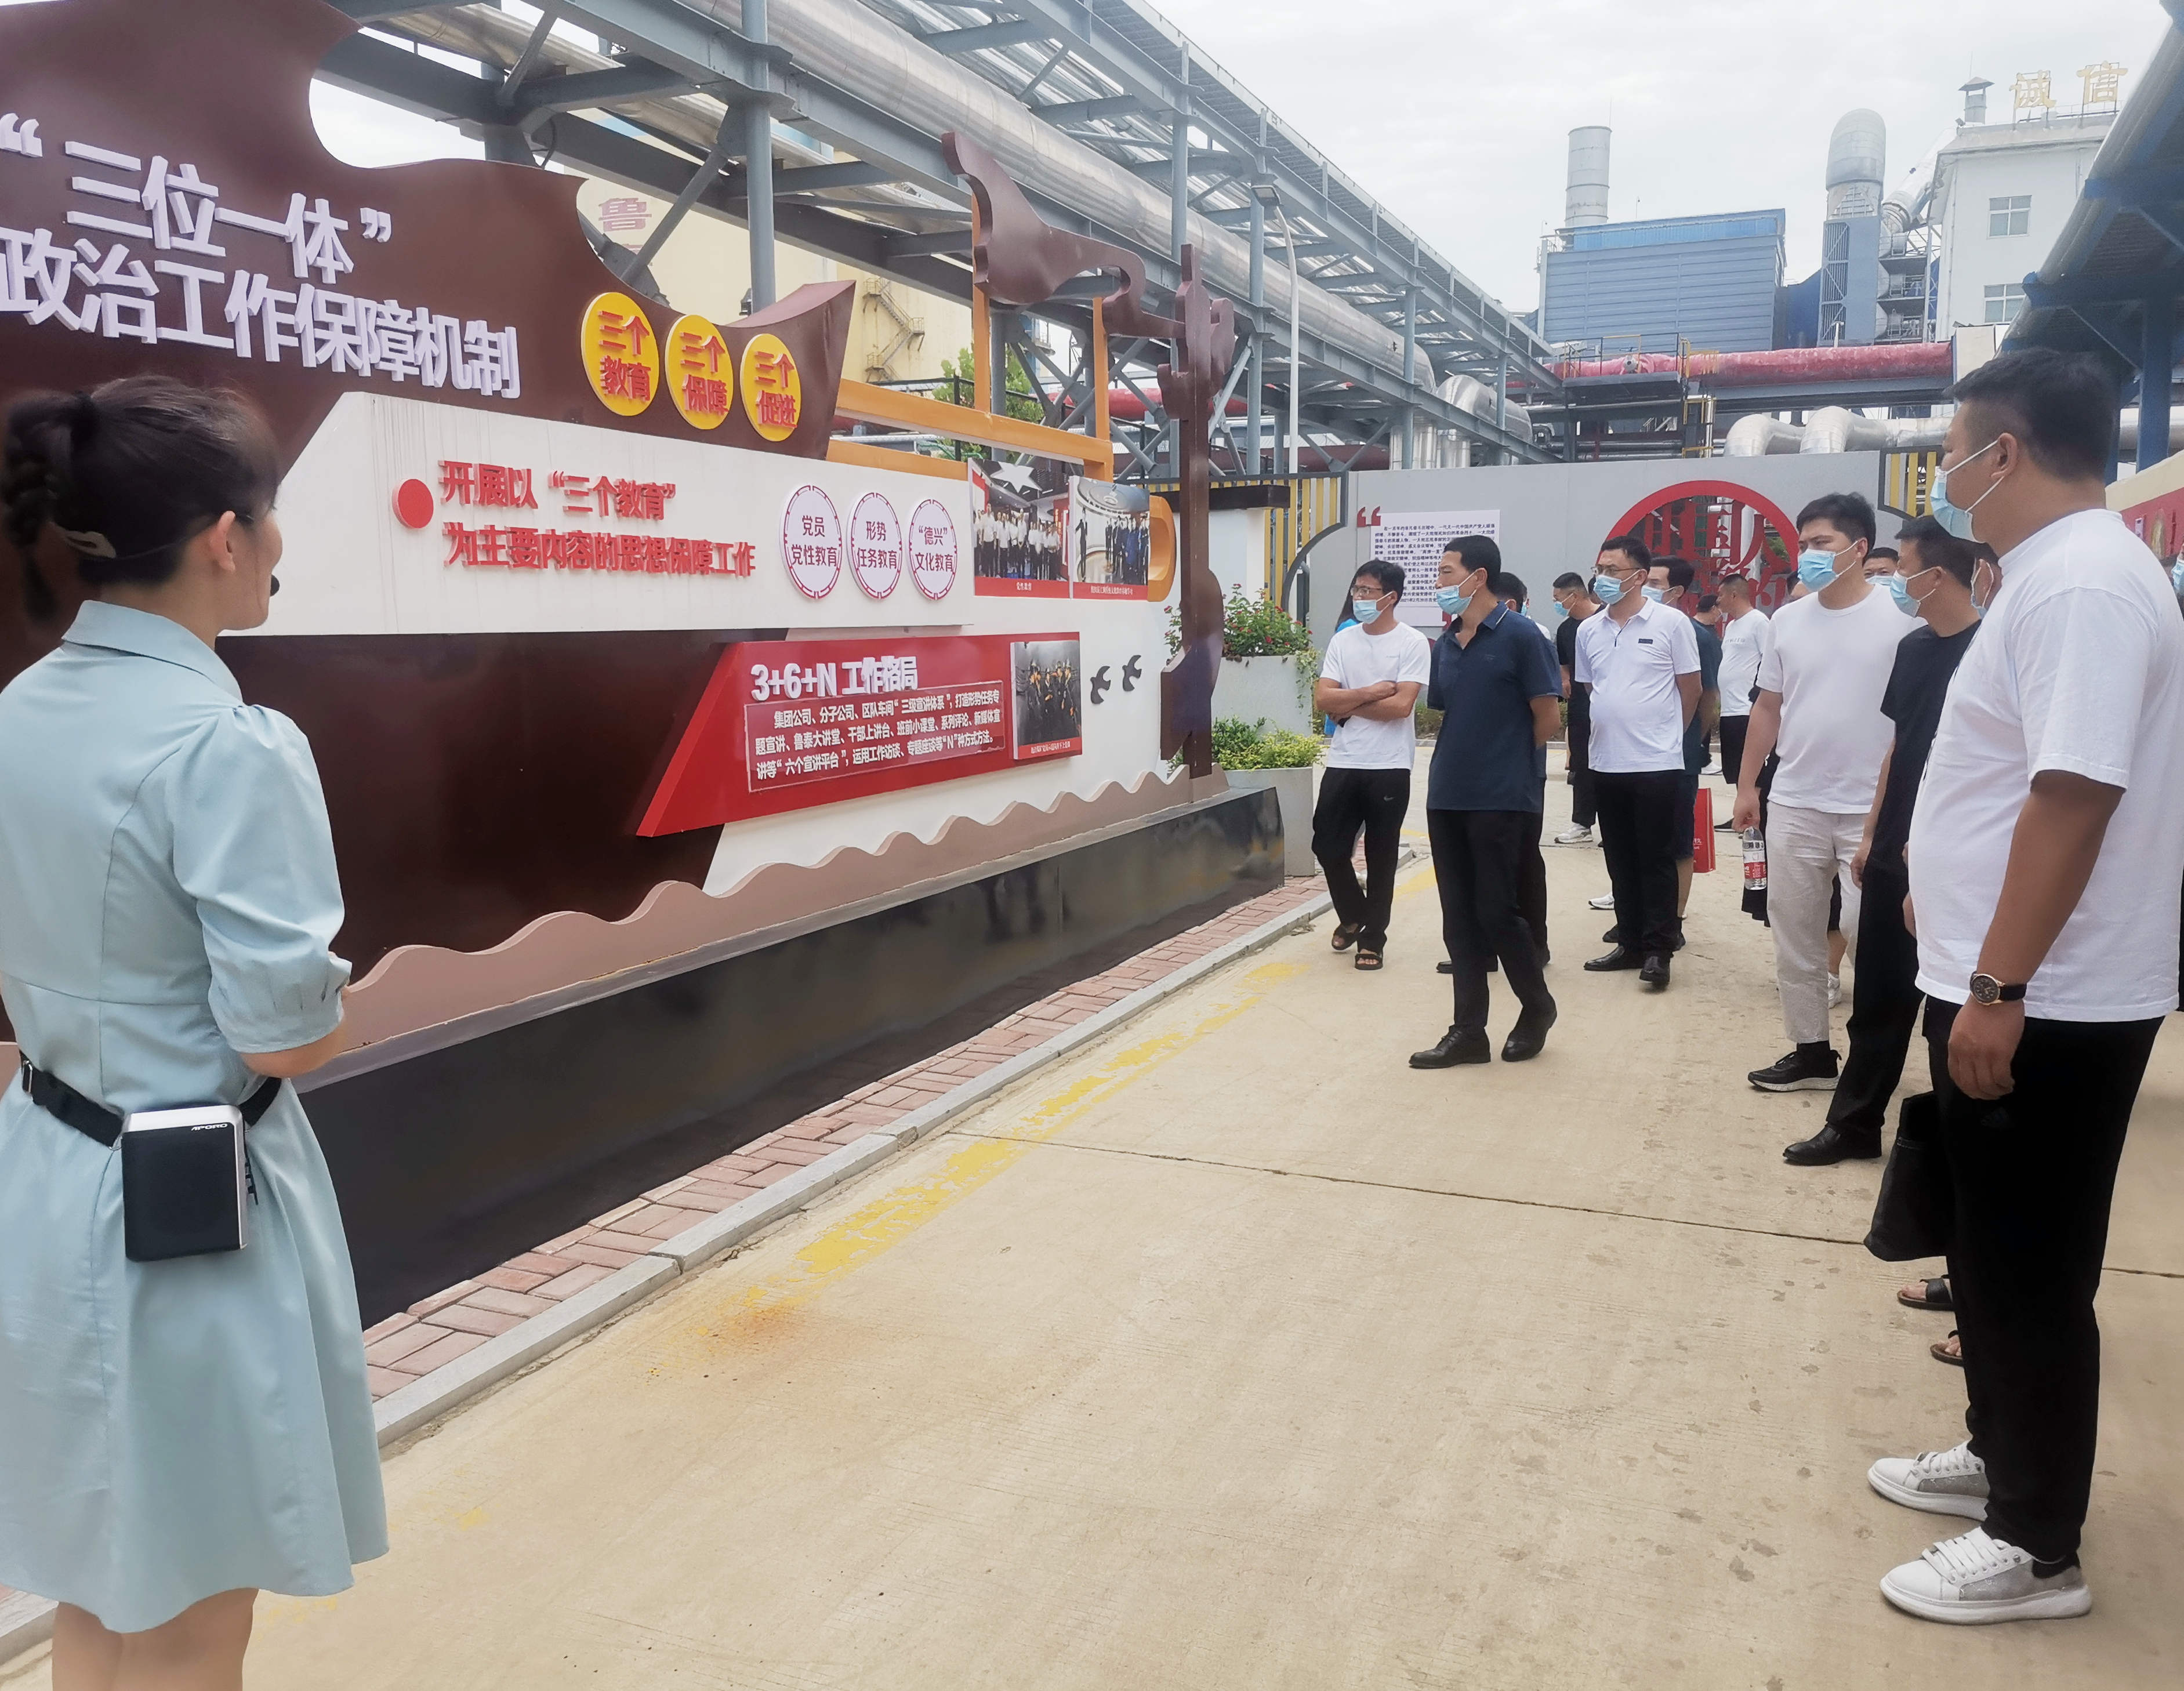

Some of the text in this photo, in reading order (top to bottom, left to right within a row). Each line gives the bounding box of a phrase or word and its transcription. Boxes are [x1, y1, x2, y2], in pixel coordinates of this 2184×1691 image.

[0, 228, 521, 399] 政治工作保障机制
[598, 310, 650, 355] 三个
[680, 332, 725, 373] 三个
[755, 351, 794, 388] 三个
[600, 355, 651, 401] 教育
[682, 374, 728, 415] 保障
[756, 390, 797, 428] 促进
[438, 460, 538, 509] 开展以
[802, 515, 825, 537] 党员
[866, 521, 886, 541] 形势
[442, 522, 756, 576] 为主要内容的思想保障工作
[791, 544, 837, 567] 党性教育
[857, 547, 897, 569] 任务教育
[915, 552, 953, 572] 文化教育
[750, 655, 919, 701] 3+6+N 工作格局
